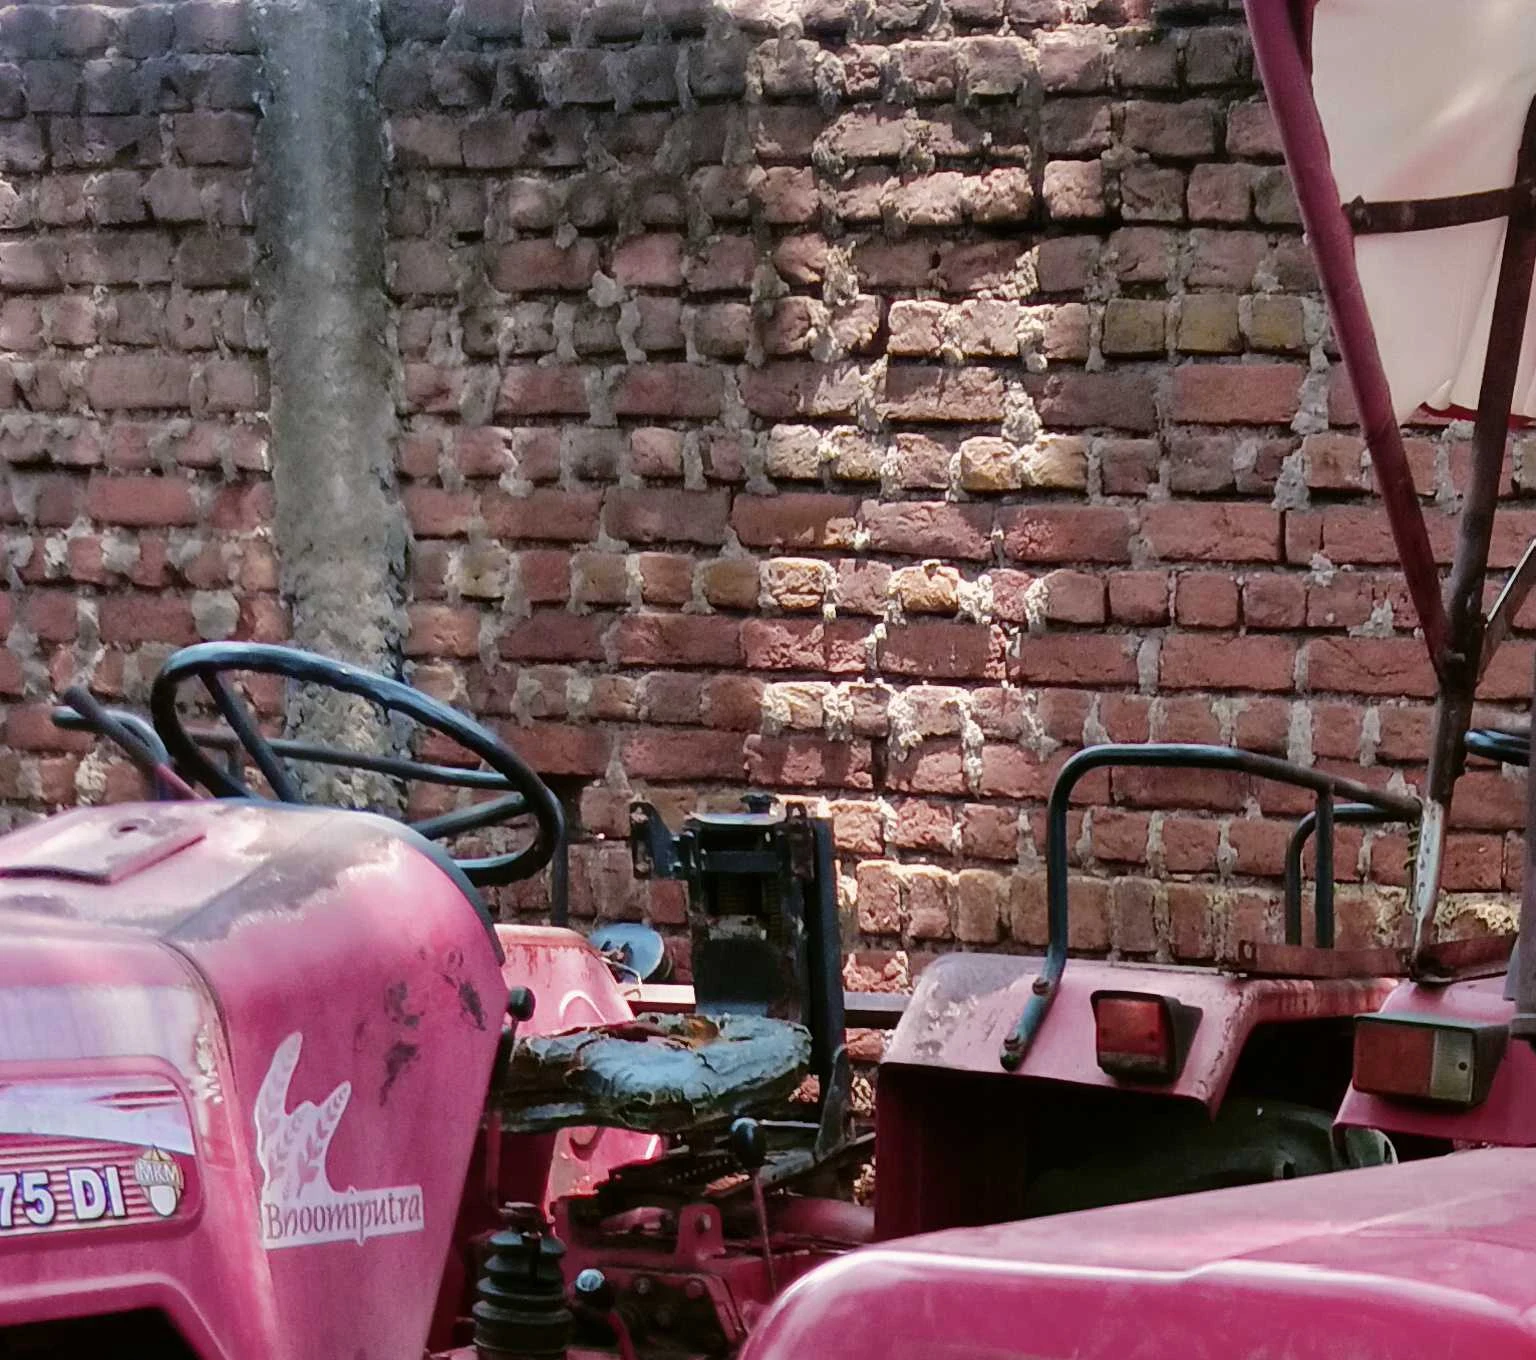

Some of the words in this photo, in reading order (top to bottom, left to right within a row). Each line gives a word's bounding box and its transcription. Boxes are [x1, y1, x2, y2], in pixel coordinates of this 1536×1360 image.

[138, 1160, 179, 1186] MKM
[0, 1170, 56, 1229] 75
[68, 1165, 126, 1220] DI
